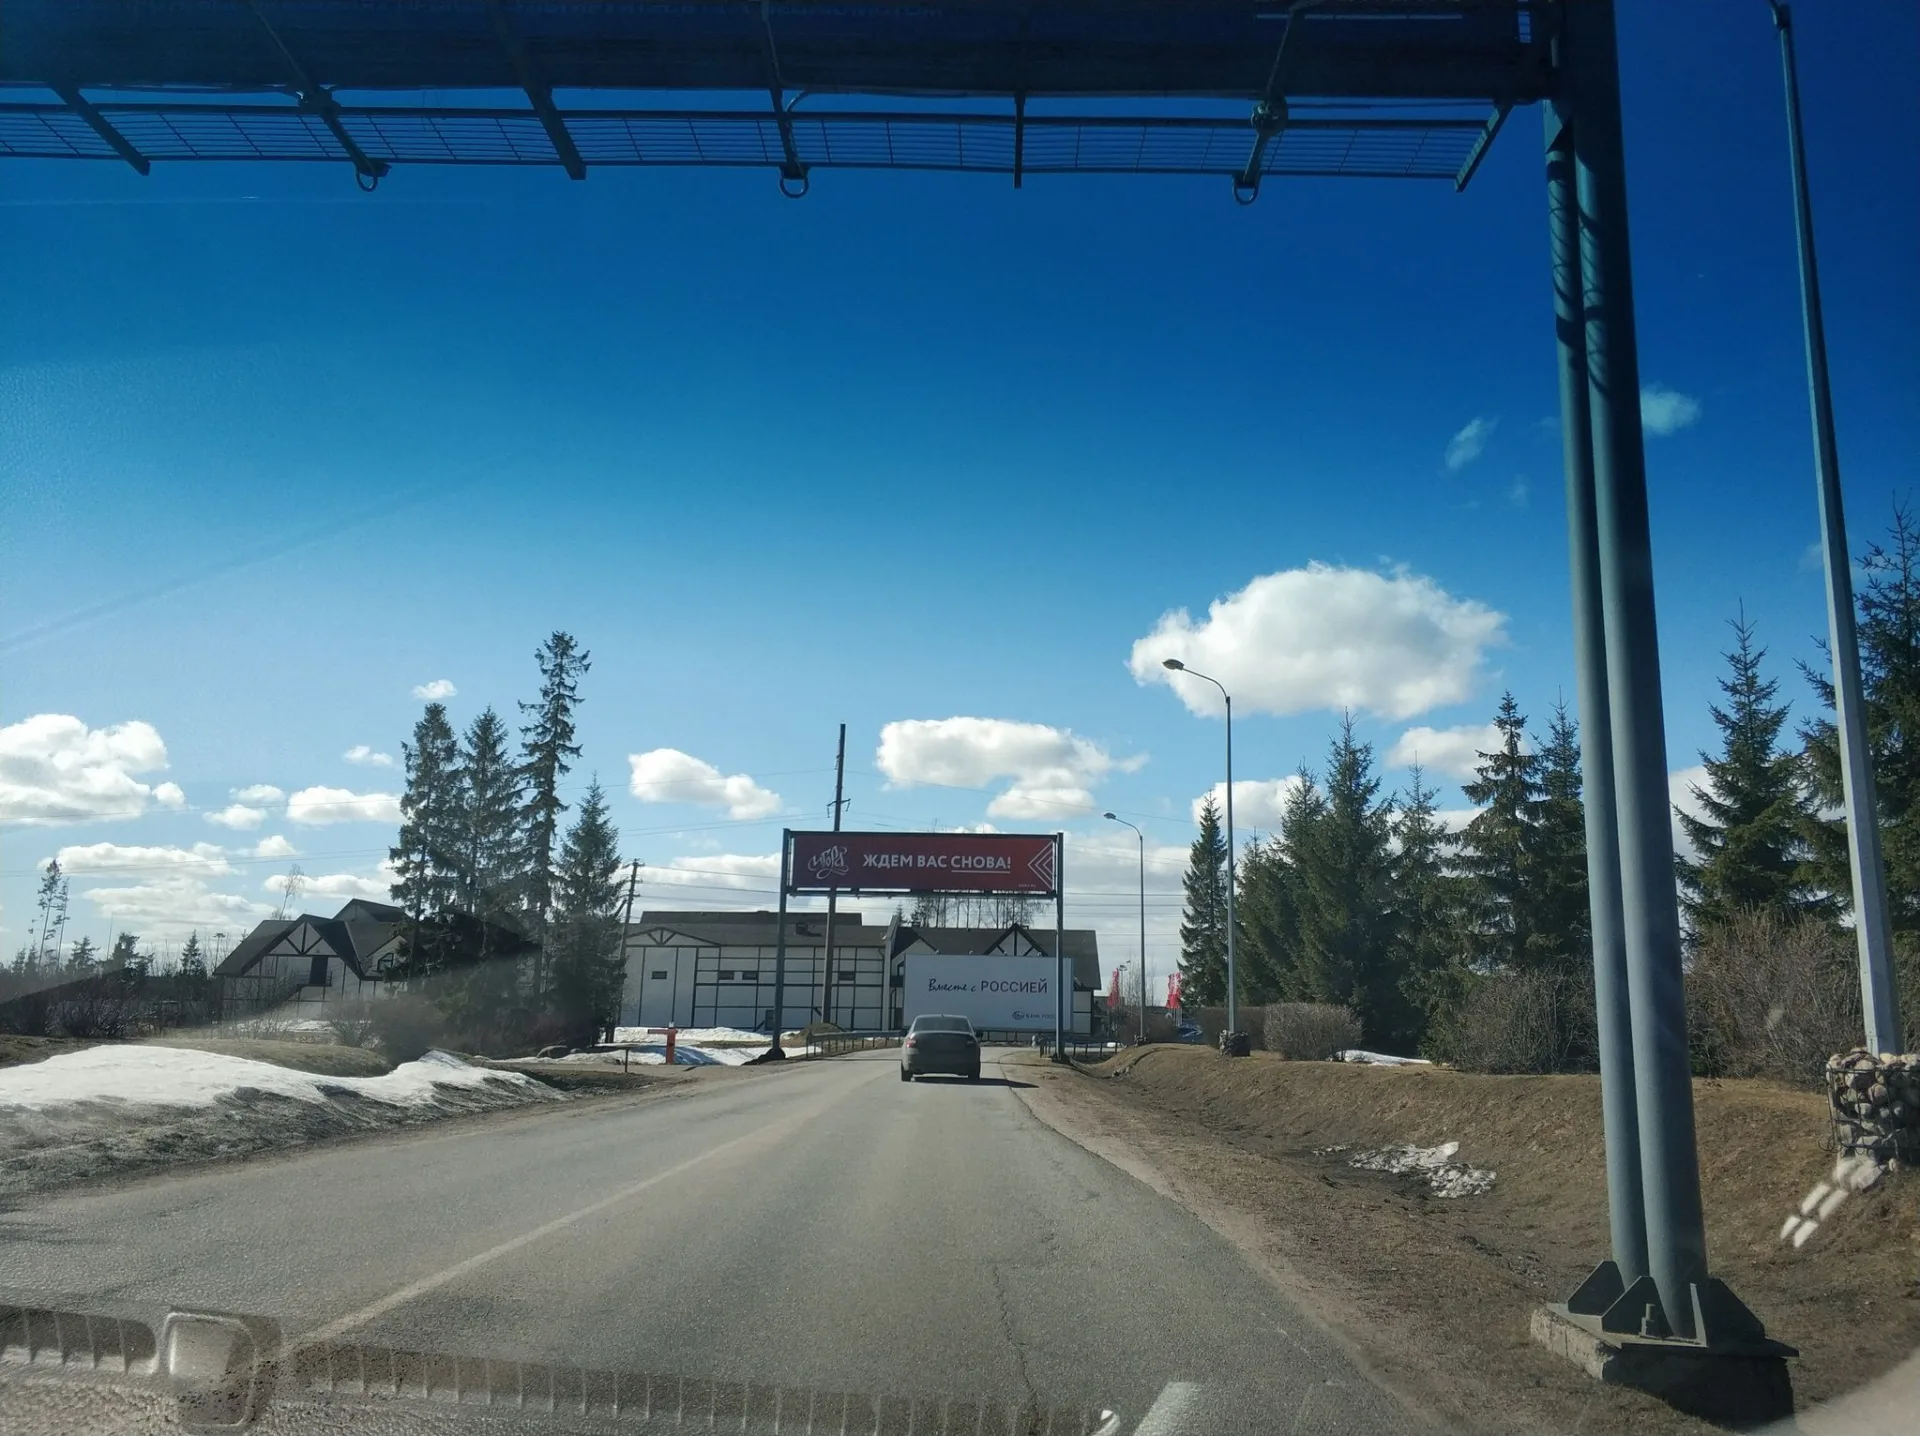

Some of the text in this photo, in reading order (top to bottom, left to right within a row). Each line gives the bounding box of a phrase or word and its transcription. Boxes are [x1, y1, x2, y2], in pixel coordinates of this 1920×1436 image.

[863, 853, 1011, 869] ЖДЕМ ВАС СНОВА!
[928, 978, 967, 993] Вместе
[981, 978, 1048, 994] РОССИЕЙ
